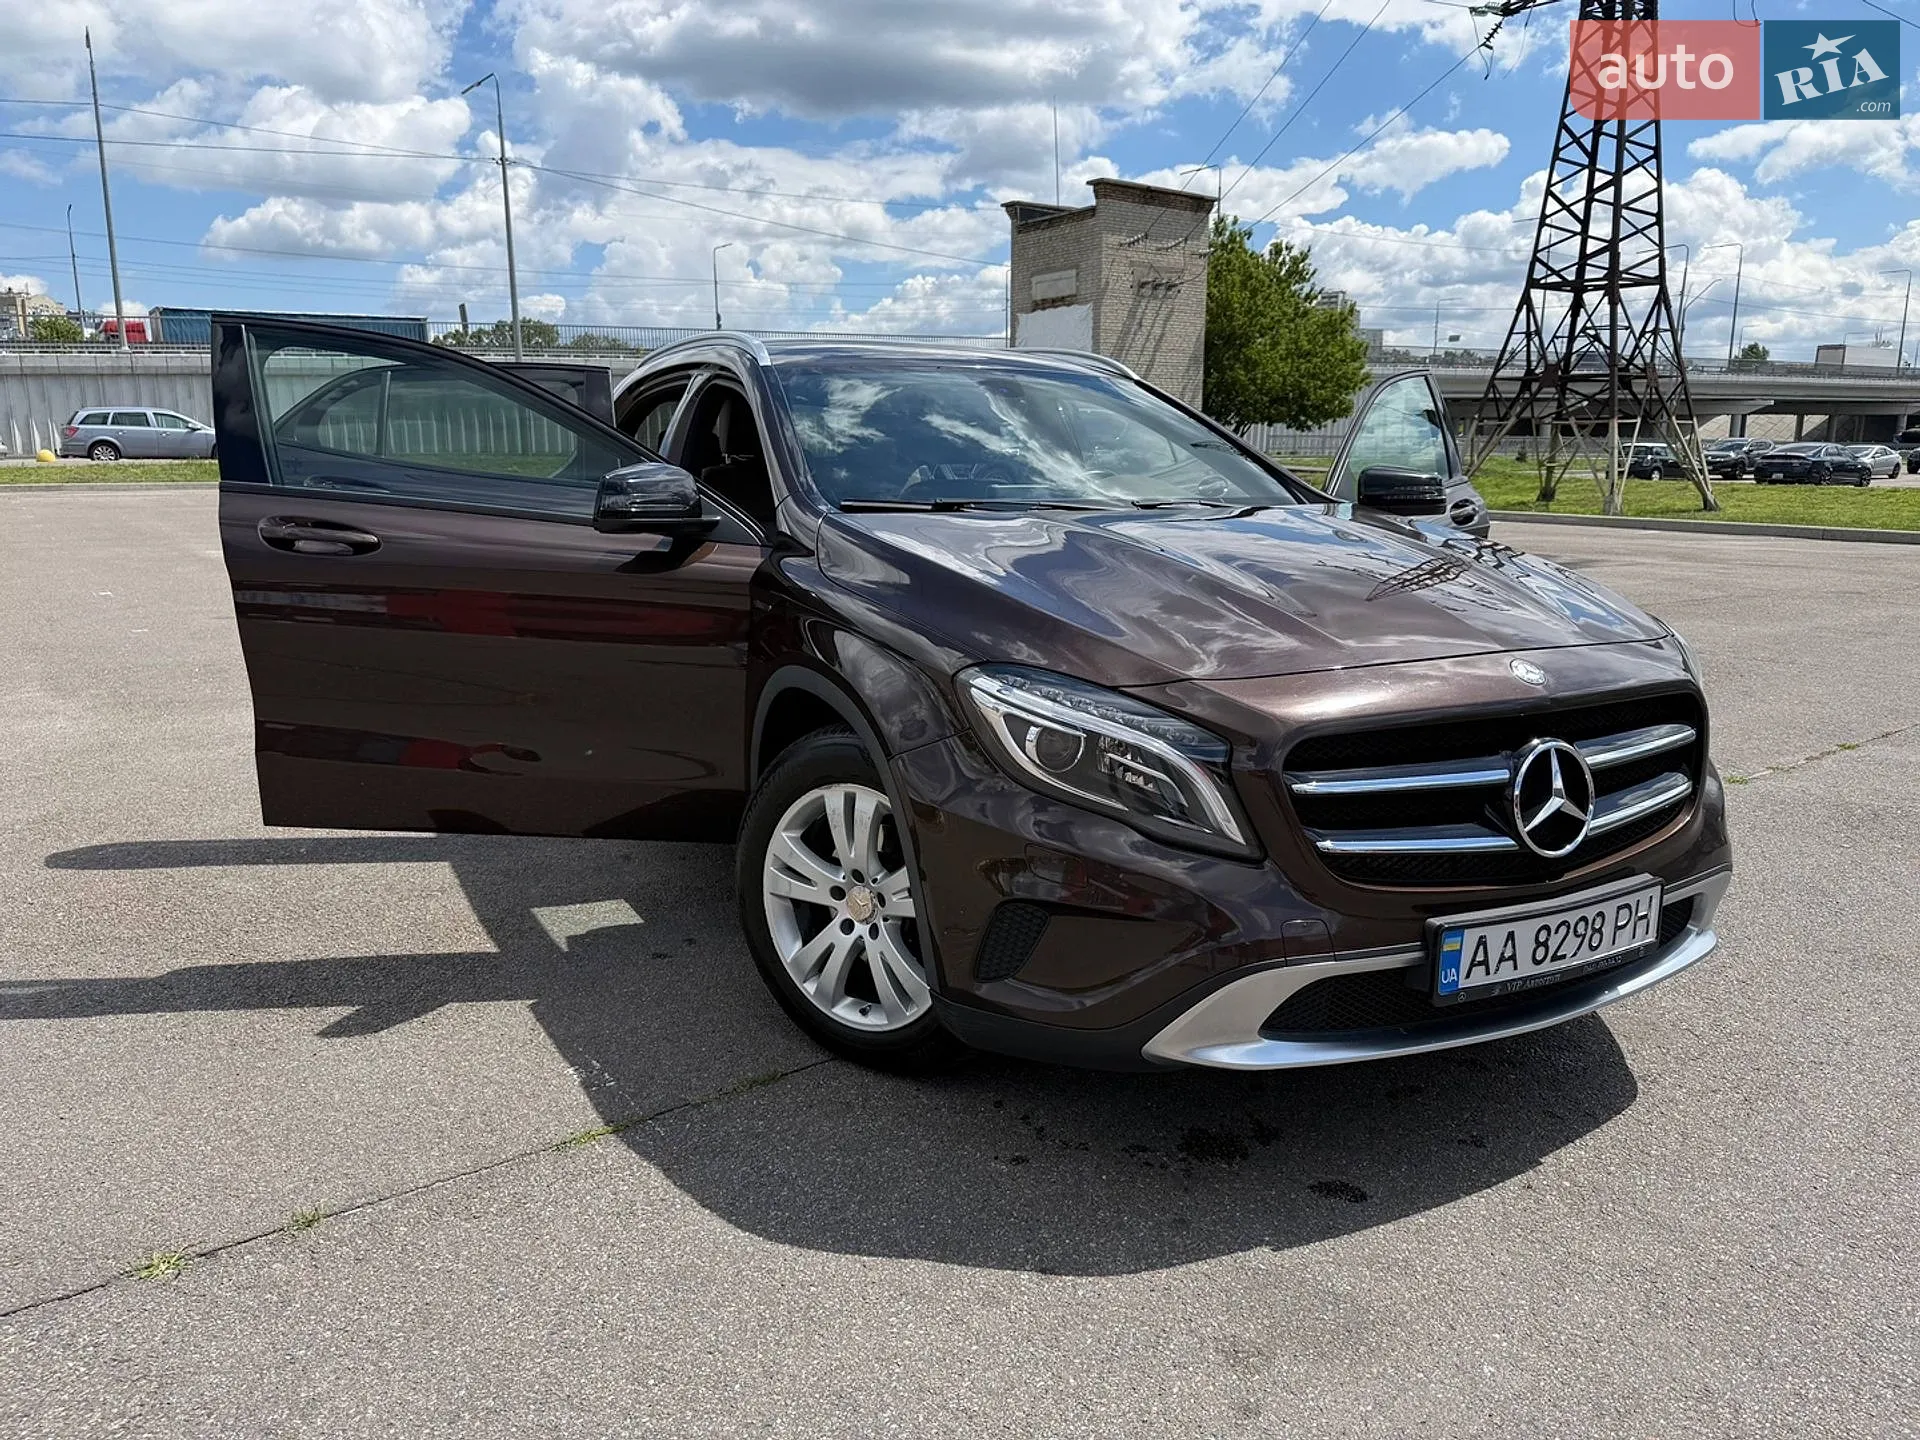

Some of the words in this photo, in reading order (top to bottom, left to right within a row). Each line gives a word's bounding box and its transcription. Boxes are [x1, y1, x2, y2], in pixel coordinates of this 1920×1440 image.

[1465, 930, 1519, 980] AA
[1531, 910, 1606, 966] 8298
[1611, 895, 1654, 947] PH
[1441, 968, 1459, 983] UA
